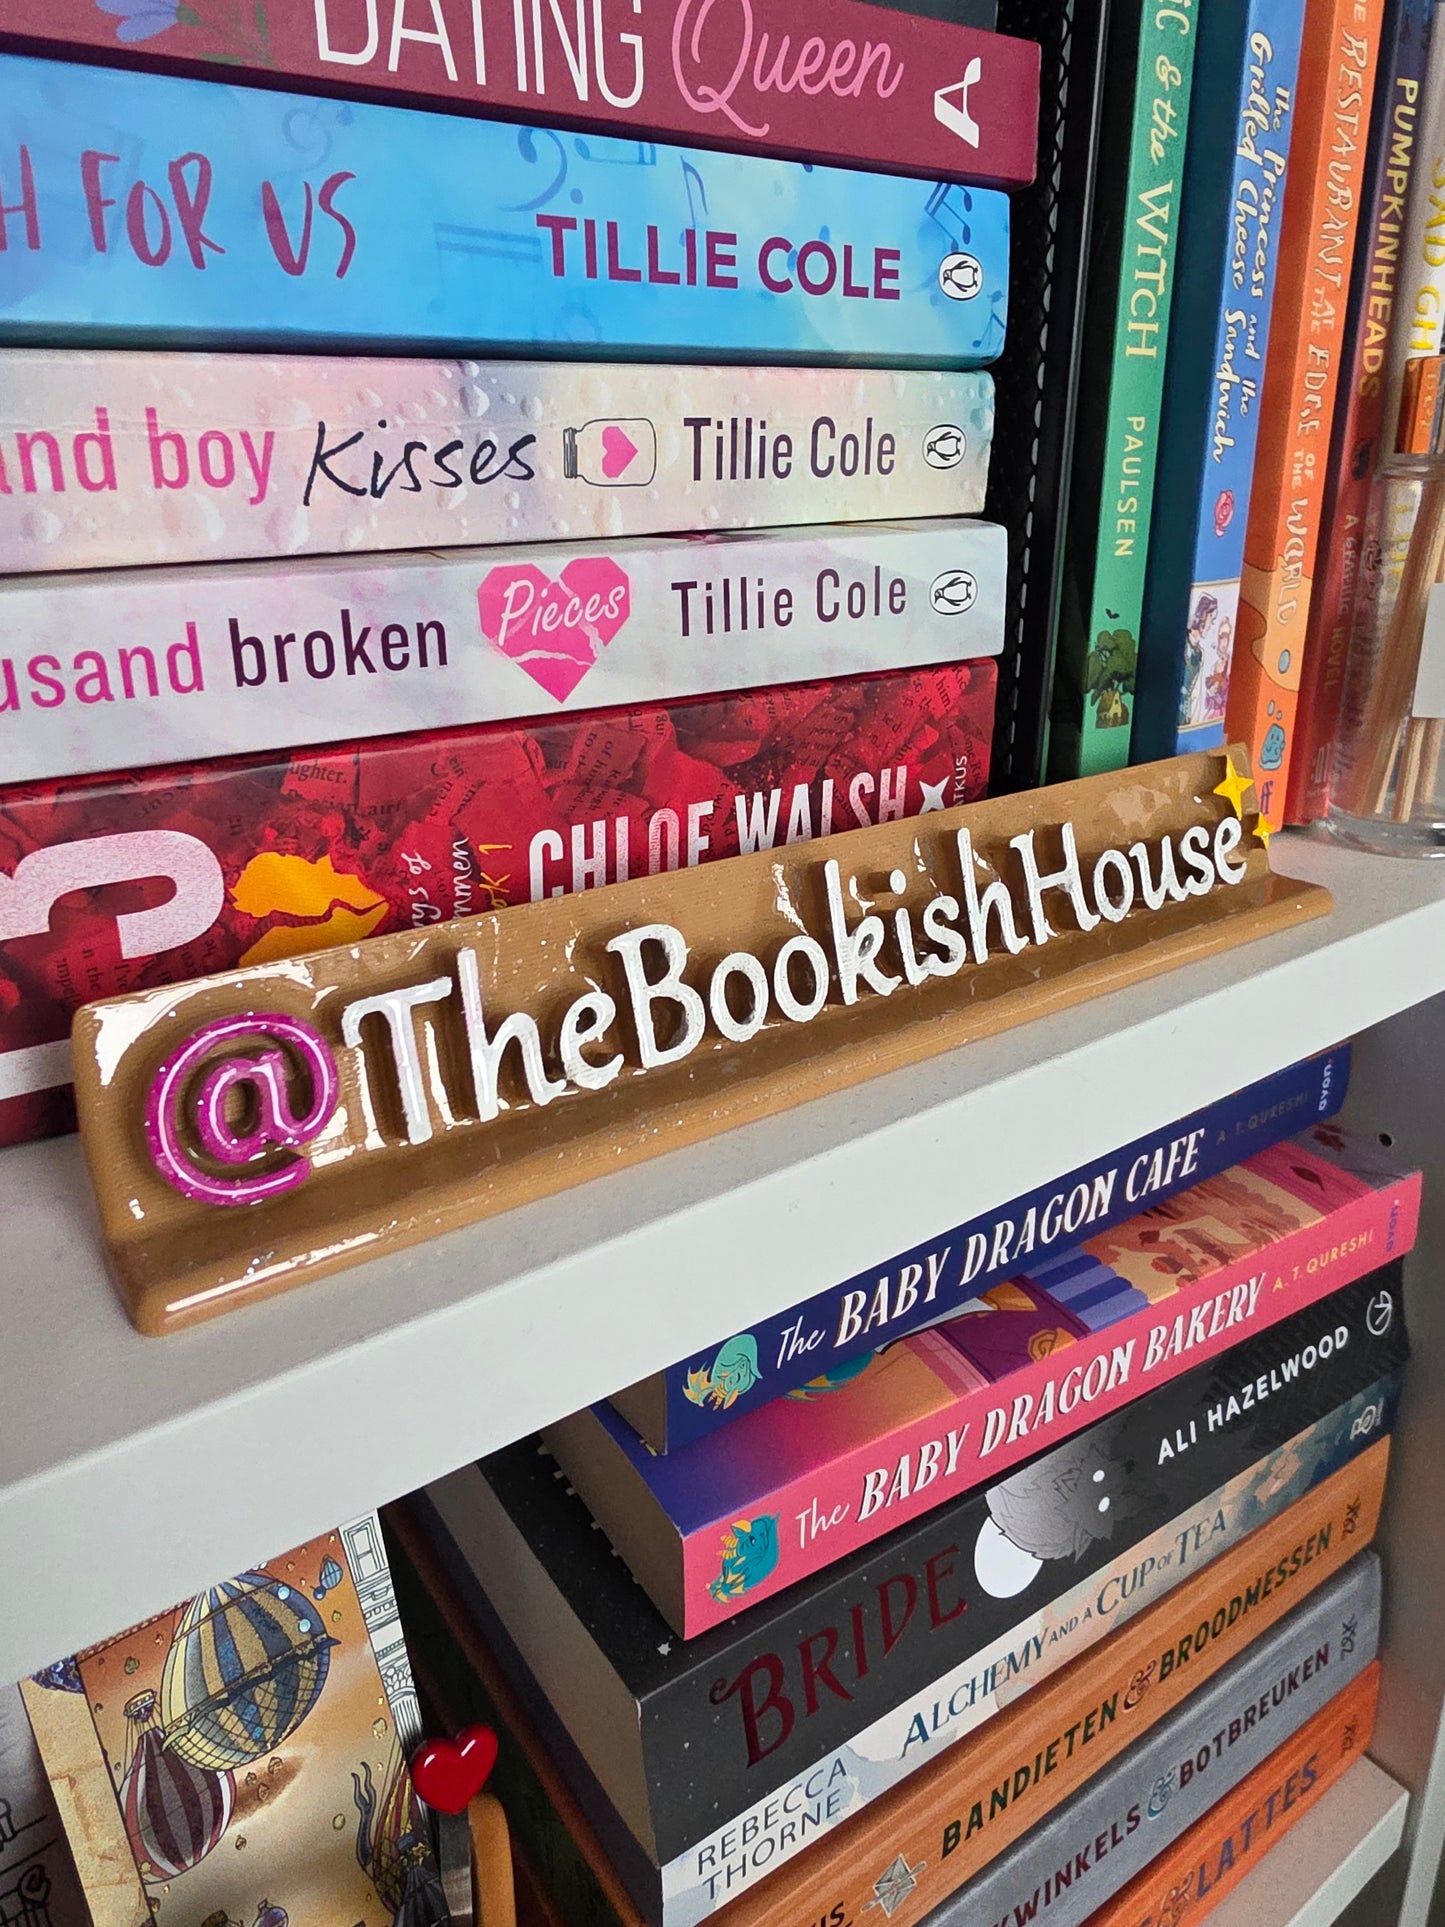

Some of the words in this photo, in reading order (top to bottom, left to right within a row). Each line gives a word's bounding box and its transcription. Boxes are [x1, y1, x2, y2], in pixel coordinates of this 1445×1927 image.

[672, 0, 904, 137] Queen
[1150, 98, 1178, 166] the
[1236, 32, 1273, 166] Grilled
[80, 150, 225, 270] FOR
[261, 171, 357, 279] US
[1314, 26, 1368, 290] RESTAURANT
[535, 214, 739, 290] TILLIE
[758, 237, 901, 300] COLE
[1126, 180, 1174, 359] WITCH
[1231, 179, 1258, 291] Cheese
[1251, 149, 1286, 298] Princess
[1358, 78, 1418, 398] PUMPKINHEADS
[1245, 314, 1261, 360] and
[1409, 286, 1441, 351] GH
[683, 417, 794, 481] Tillie
[810, 416, 895, 479] Cole
[1212, 308, 1246, 464] Sandwich
[1297, 344, 1331, 436] EDGE
[0, 406, 117, 494] nd
[145, 407, 275, 504] boy
[1114, 416, 1145, 557] PAULSEN
[1292, 448, 1305, 491] THE
[1305, 453, 1317, 481] OF
[671, 577, 794, 636] Tillie
[816, 565, 907, 622] Cole
[1277, 498, 1309, 625] WORLD
[229, 609, 448, 688] broken
[497, 579, 626, 644] Pieces
[411, 885, 442, 928] ys
[144, 816, 1250, 1206] @TheBookishHouse
[1248, 1092, 1309, 1130] QURESHI
[778, 1315, 825, 1368] The
[834, 1246, 950, 1348] BABY
[960, 1169, 1118, 1287] DRAGON
[1126, 1129, 1205, 1202] CAFE
[1306, 1229, 1375, 1275] QURESHI
[796, 1497, 850, 1549] The
[857, 1423, 970, 1522] BABY
[979, 1339, 1136, 1459] DRAGON
[1142, 1273, 1266, 1373] BAKERY
[1158, 1421, 1198, 1465] ALI
[1207, 1325, 1349, 1432] HAZELWOOD
[709, 1544, 967, 1769] BRIDE
[900, 1627, 1049, 1760] ALCHEMY
[1048, 1616, 1079, 1646] AND
[1082, 1607, 1092, 1624] A
[1096, 1557, 1155, 1616] CUP
[1176, 1509, 1225, 1565] TEA
[941, 1692, 1119, 1860] BANDIETEN
[1123, 1660, 1157, 1714] &
[1158, 1522, 1333, 1683] BROODMESSEN
[1179, 1641, 1330, 1791] BOTBREUKEN
[698, 1757, 847, 1876] REBECCA
[701, 1789, 841, 1900] THORNE
[1197, 1751, 1317, 1899] LATTES
